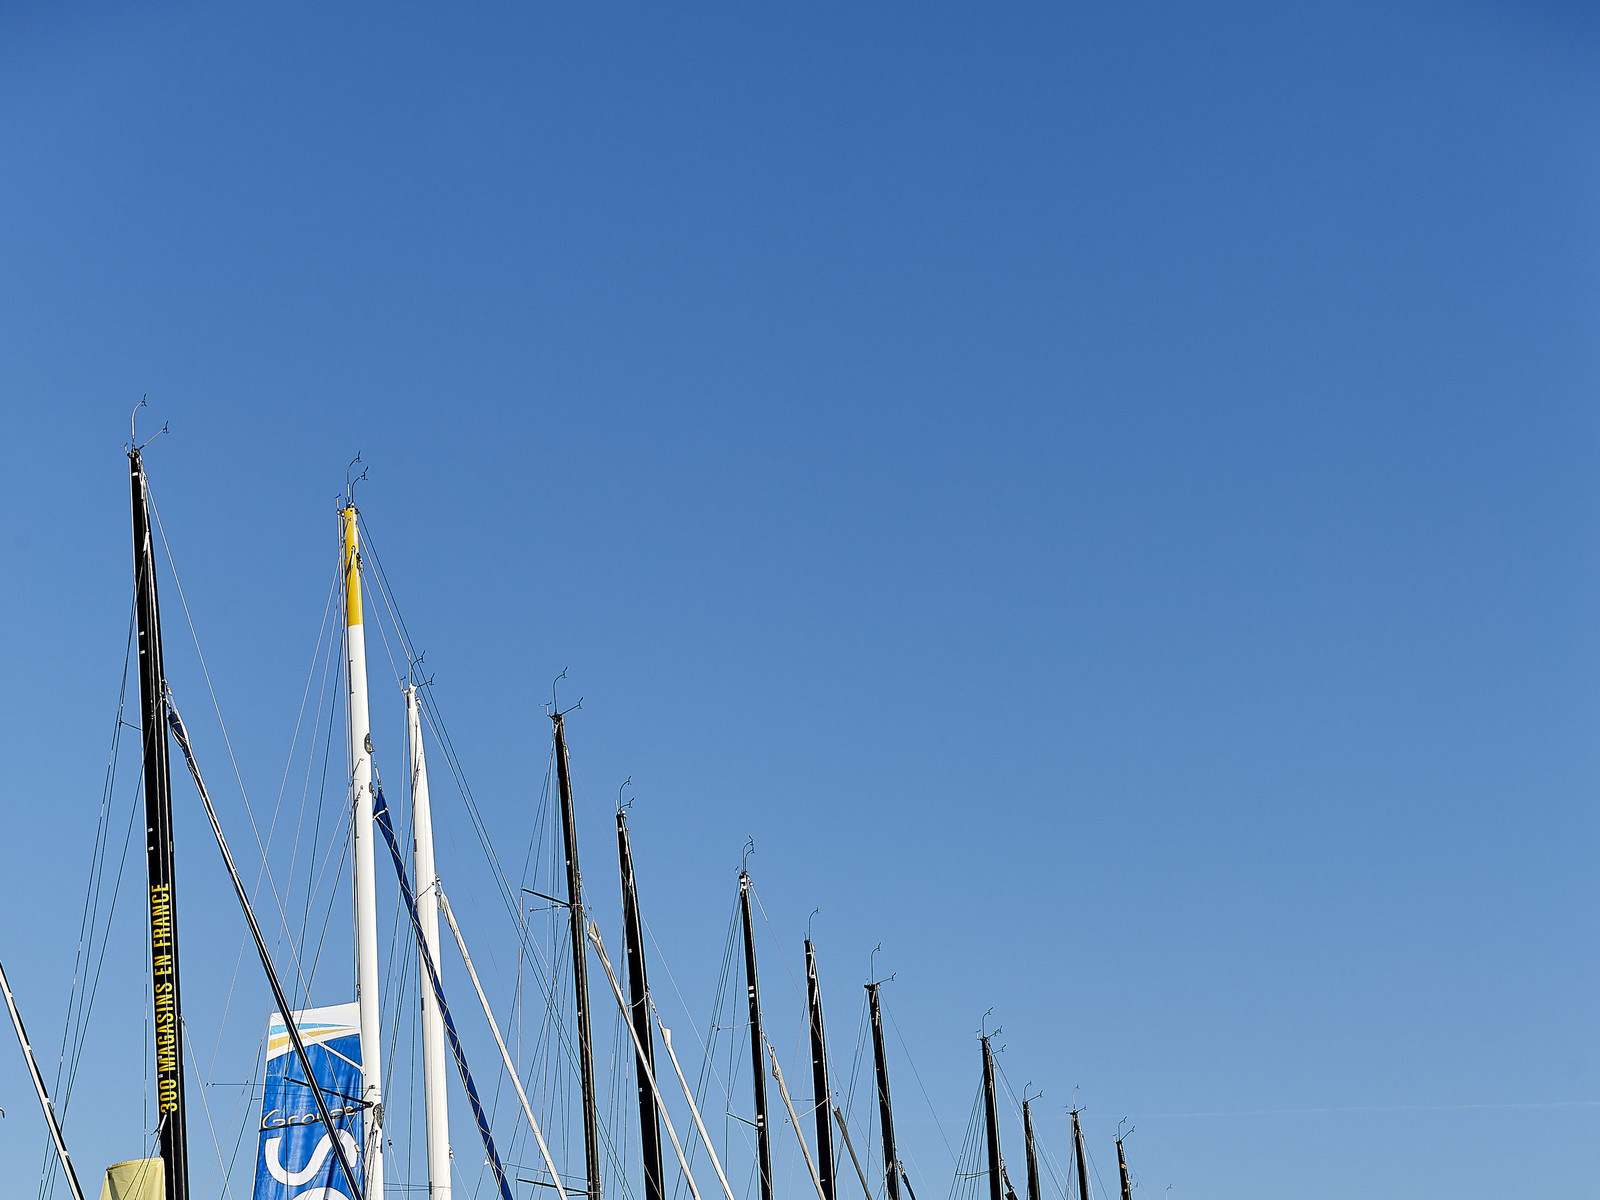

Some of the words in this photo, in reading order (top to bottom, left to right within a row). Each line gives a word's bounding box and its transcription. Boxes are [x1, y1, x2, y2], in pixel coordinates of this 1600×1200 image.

[151, 882, 171, 948] FRANCE
[154, 953, 172, 977] EN
[155, 981, 176, 1074] MAGASINS
[160, 1078, 178, 1114] 300
